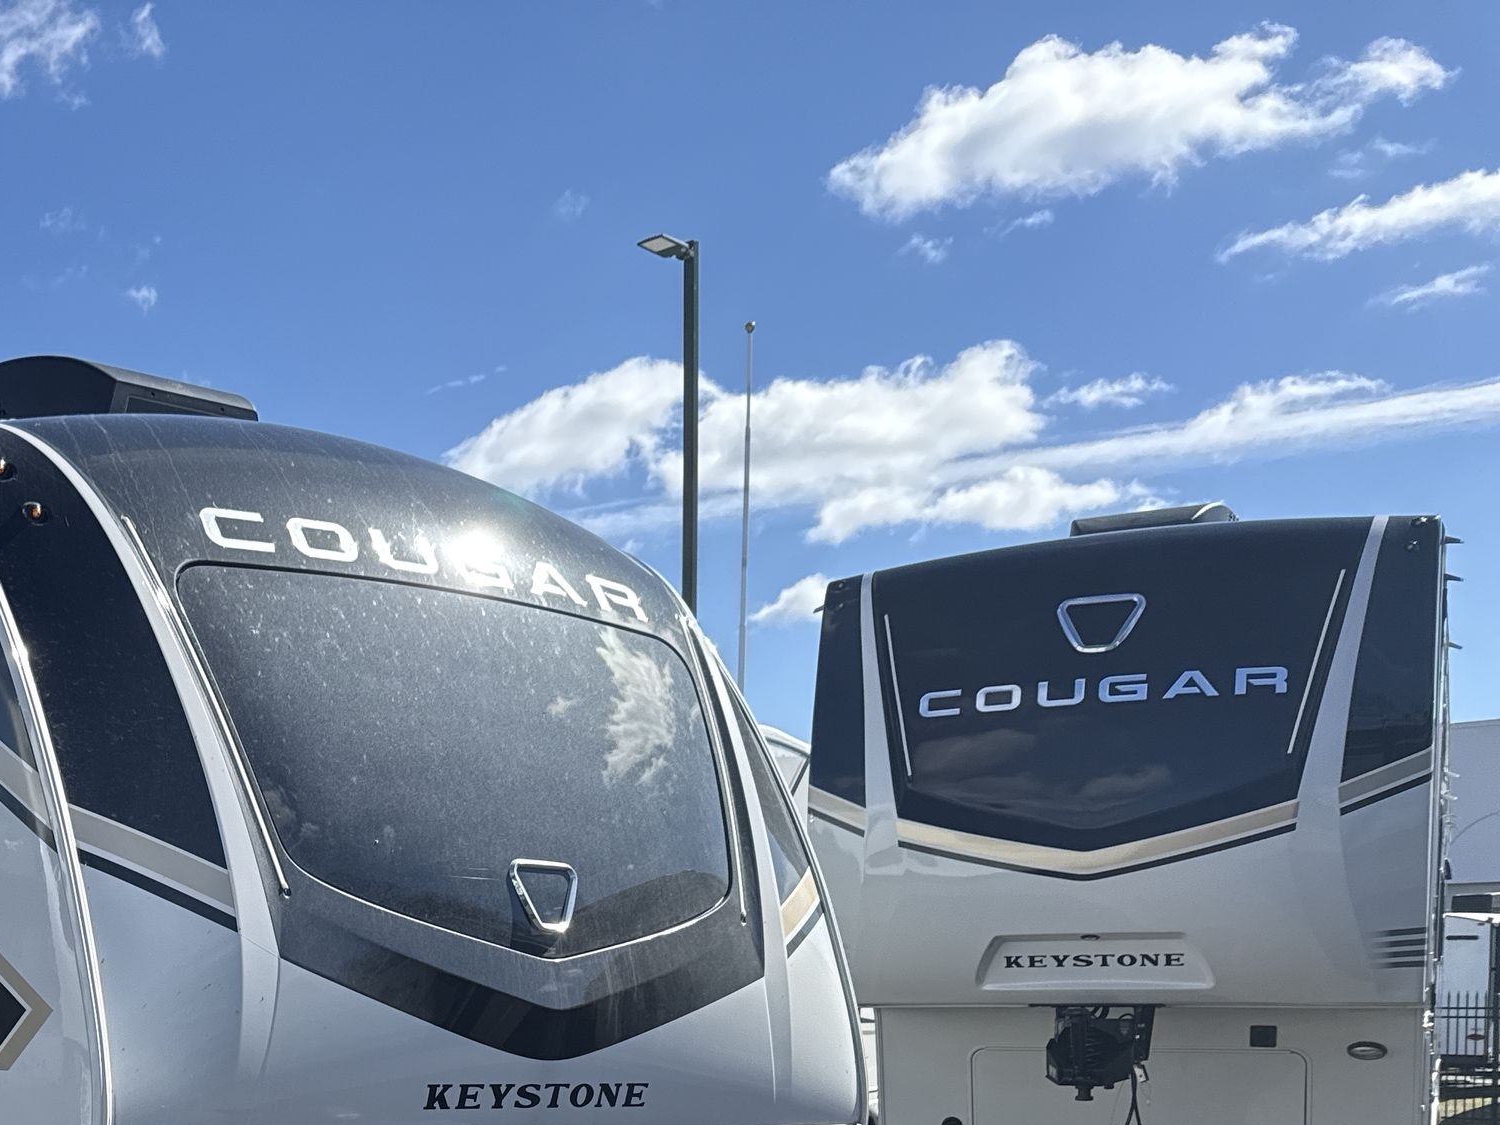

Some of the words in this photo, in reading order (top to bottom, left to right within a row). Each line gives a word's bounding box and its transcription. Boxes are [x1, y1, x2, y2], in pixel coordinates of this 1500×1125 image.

[199, 506, 650, 624] COUGAR
[919, 666, 1289, 718] COUGAR
[1004, 953, 1185, 968] KEYSTONE
[423, 1083, 649, 1110] KEYSTONE
